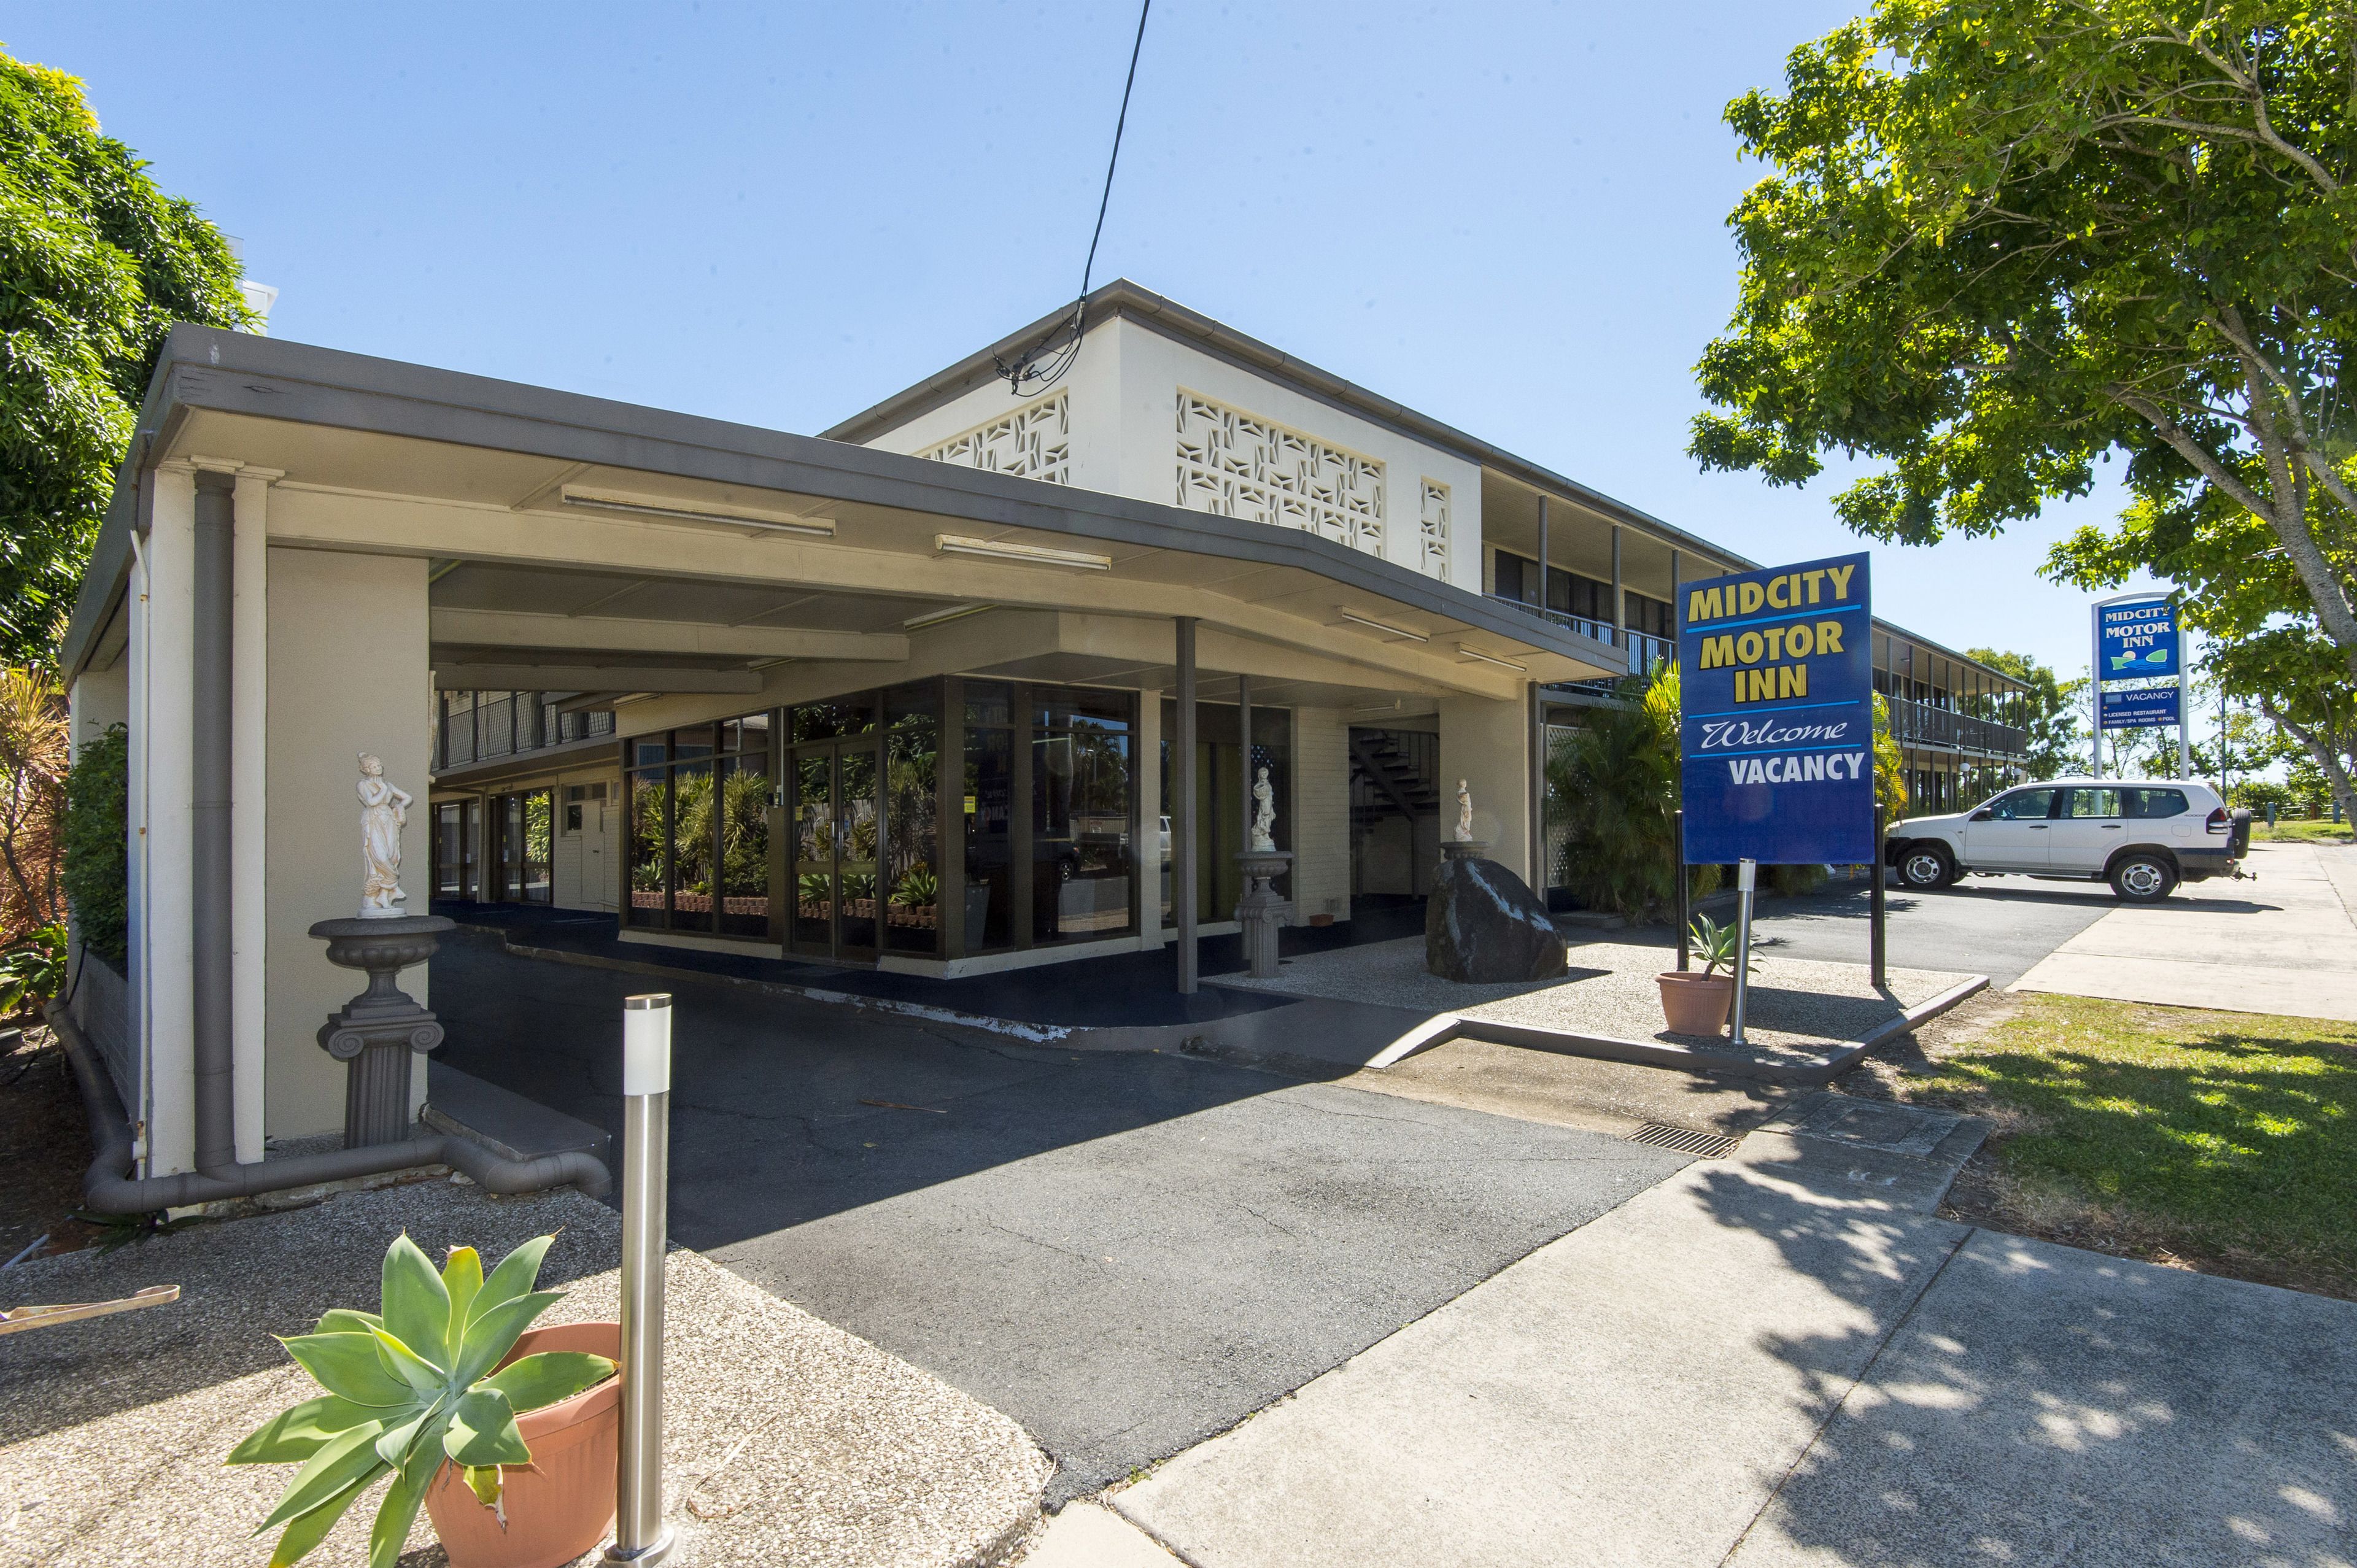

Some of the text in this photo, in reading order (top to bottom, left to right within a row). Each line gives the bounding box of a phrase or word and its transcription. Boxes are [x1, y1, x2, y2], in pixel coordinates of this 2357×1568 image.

[1687, 564, 1855, 622] MIDCITY
[2105, 606, 2171, 622] MIDCITY
[2106, 622, 2170, 638] MOTOR
[2123, 635, 2154, 648] INN
[1700, 621, 1844, 670] MOTOR
[1734, 663, 1808, 703] INN
[2126, 691, 2173, 701] VACANCY
[1701, 719, 1847, 749] Welcome
[1728, 753, 1865, 784] VACANCY
